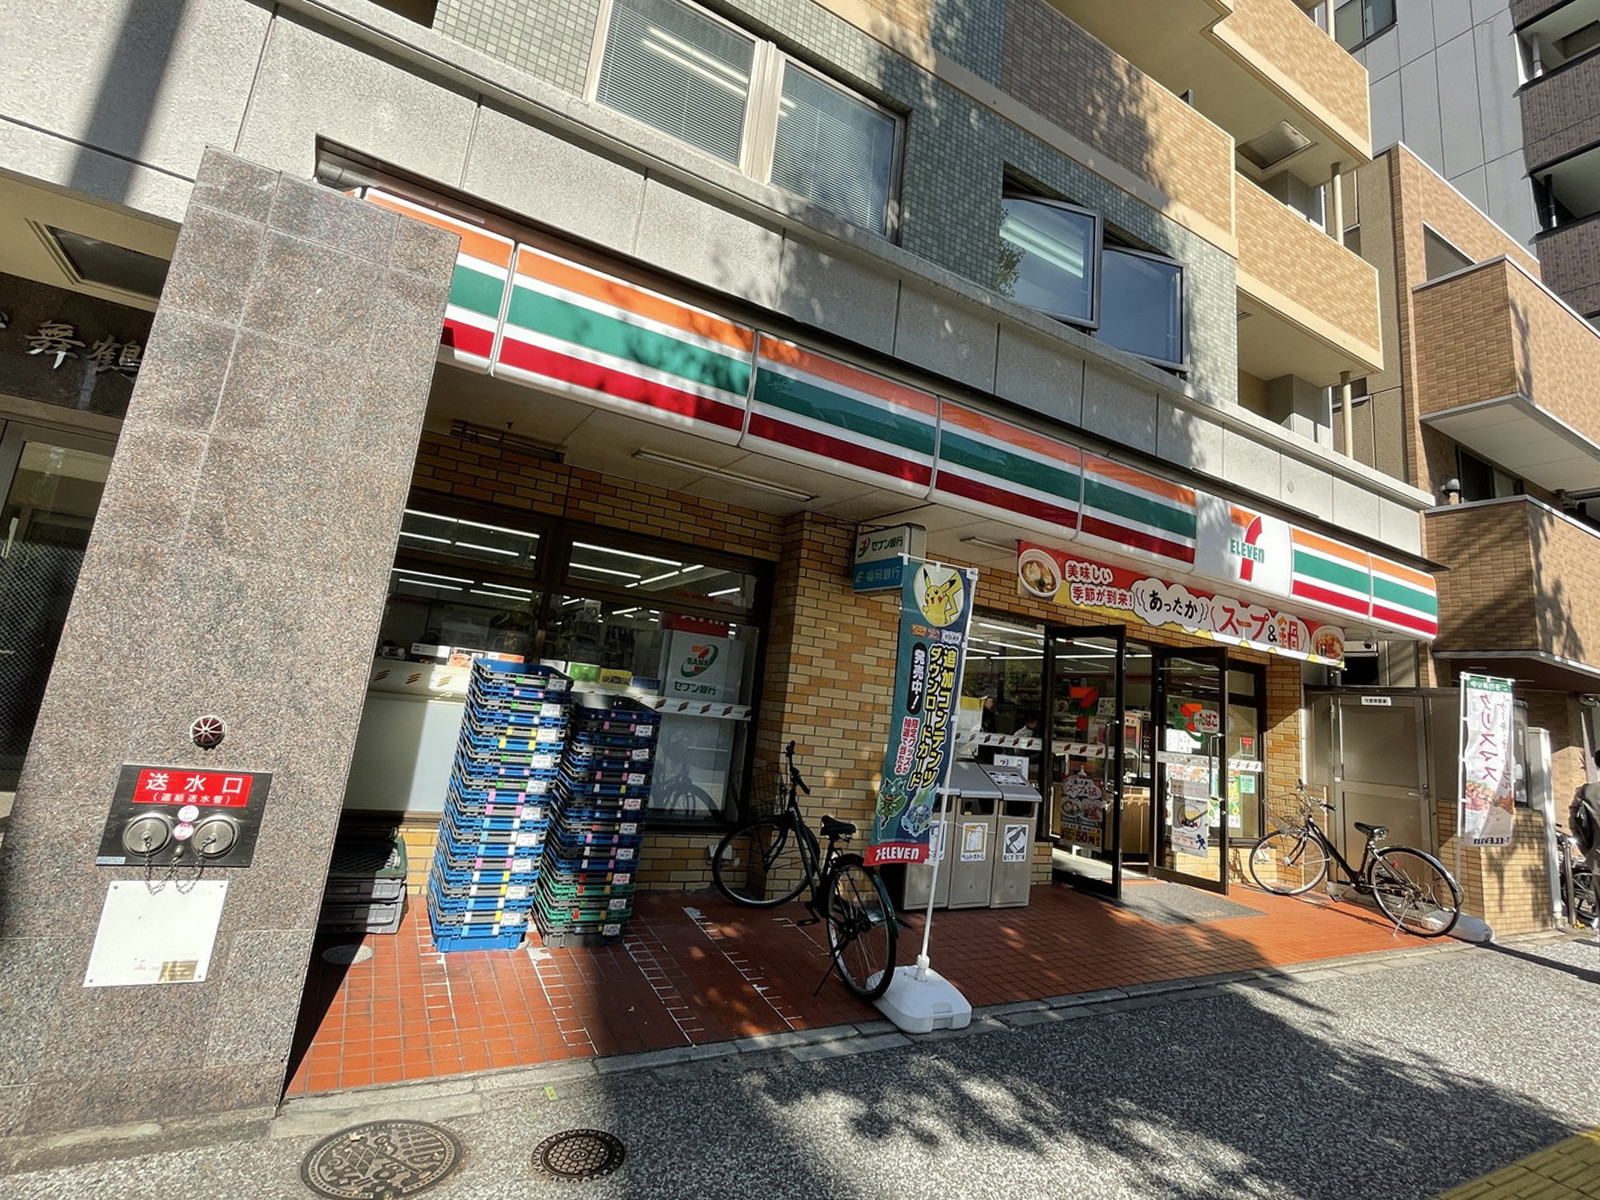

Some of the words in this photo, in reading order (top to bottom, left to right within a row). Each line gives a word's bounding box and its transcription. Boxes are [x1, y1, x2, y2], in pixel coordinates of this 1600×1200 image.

[0, 312, 141, 382] 舞鶴
[1067, 562, 1112, 582] 美味しい
[1148, 590, 1198, 620] あったか
[674, 681, 716, 695] セブン銀行
[908, 646, 943, 789] ダウンロードカード
[922, 648, 957, 788] 追加コンテンツ
[145, 772, 244, 795] 送水口
